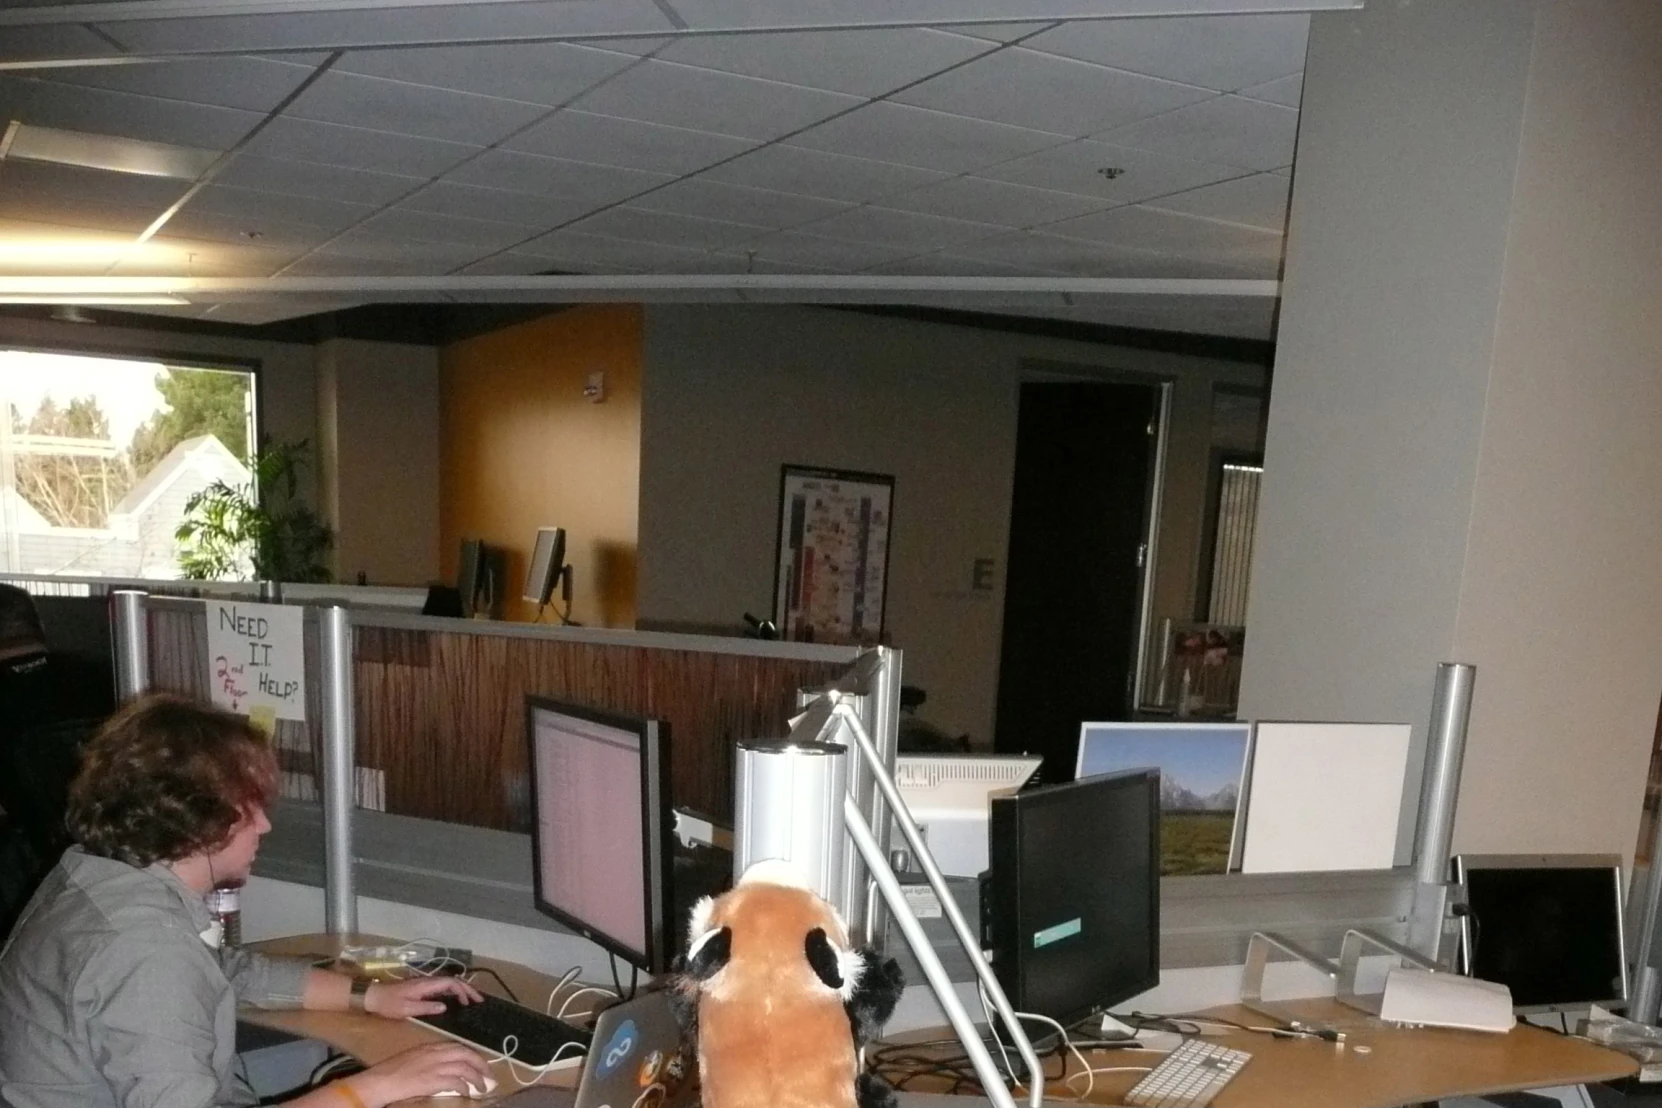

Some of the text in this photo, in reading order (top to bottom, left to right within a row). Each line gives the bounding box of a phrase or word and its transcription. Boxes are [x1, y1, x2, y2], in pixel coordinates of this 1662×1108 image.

[972, 558, 995, 591] E
[219, 605, 269, 639] NEED
[215, 655, 244, 678] 2nd
[258, 672, 299, 703] HELP?
